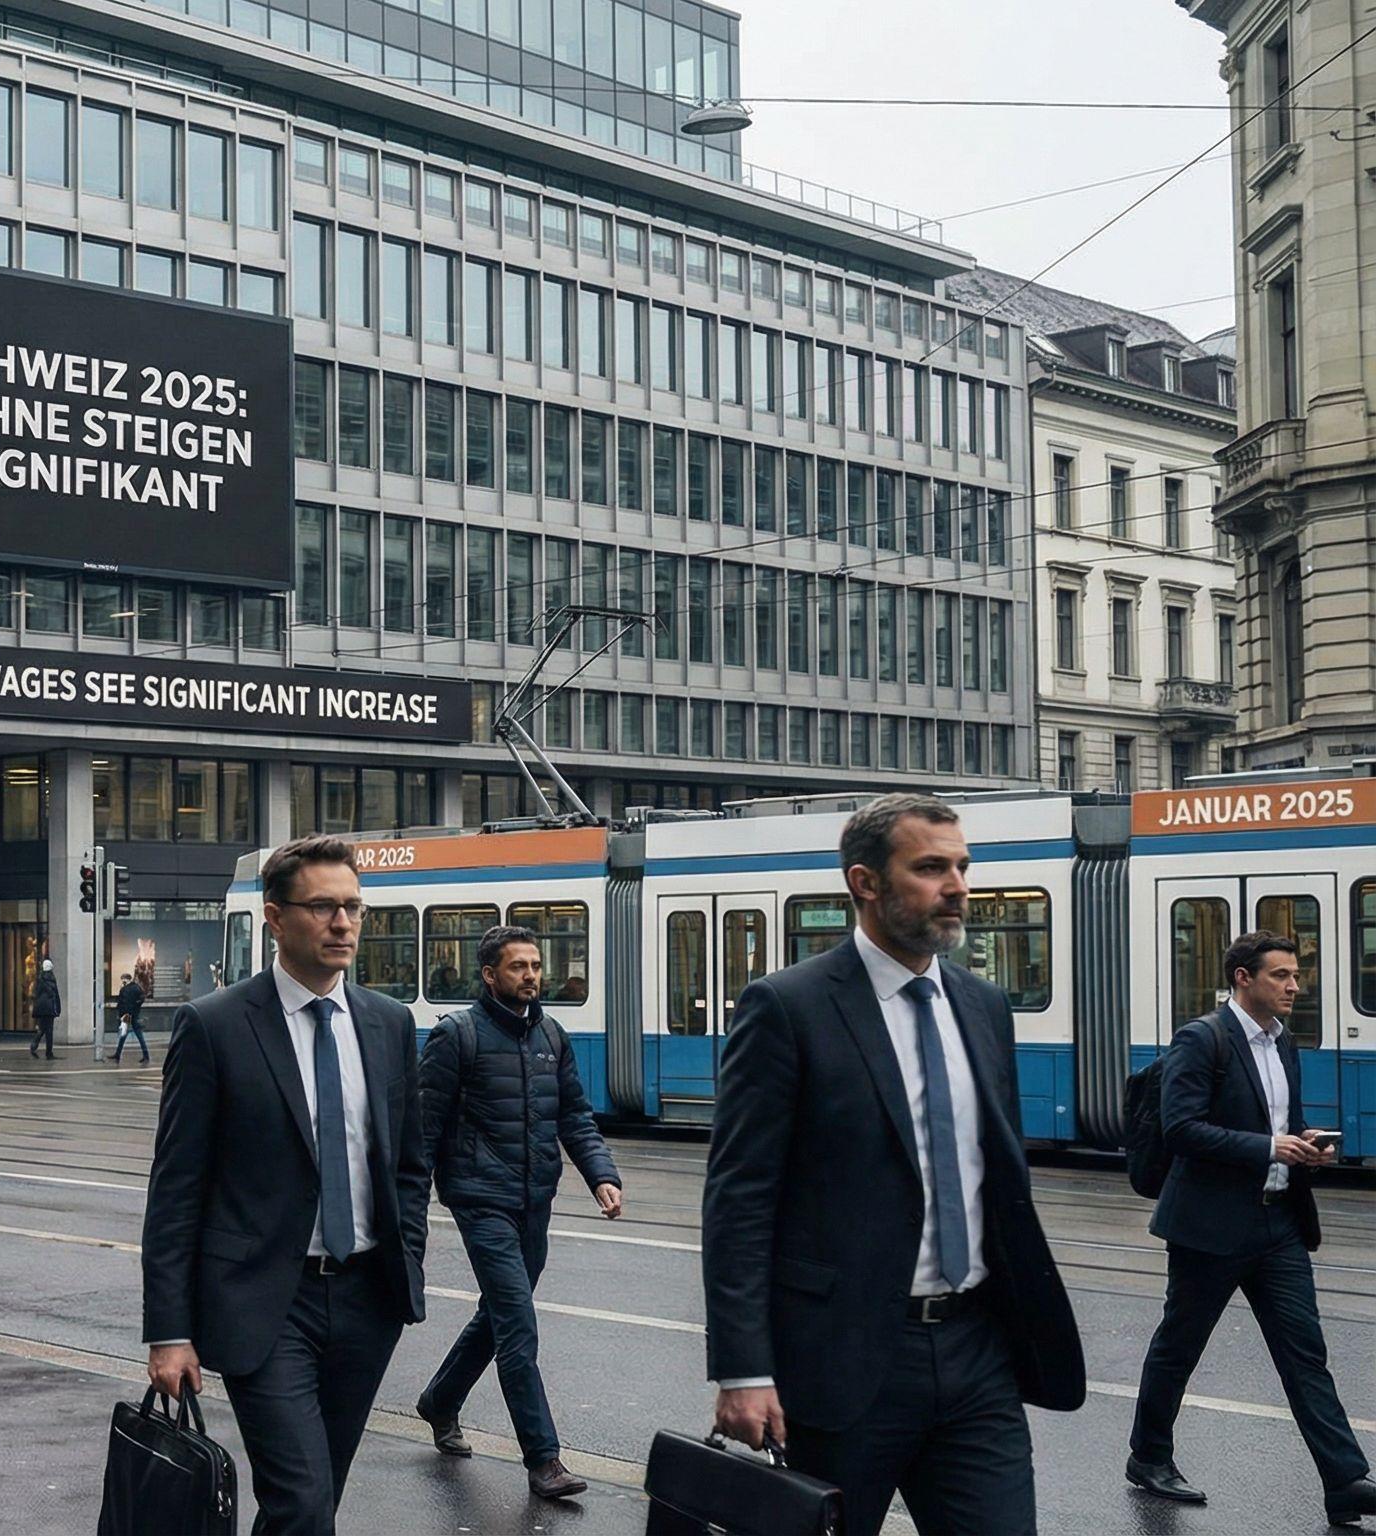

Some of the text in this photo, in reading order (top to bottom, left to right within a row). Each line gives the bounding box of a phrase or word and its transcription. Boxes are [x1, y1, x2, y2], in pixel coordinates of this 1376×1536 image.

[139, 366, 248, 418] 2025:
[82, 408, 252, 467] STEIGEN
[85, 672, 135, 704] SEE
[143, 676, 310, 715] SIGNIFICANT
[319, 688, 437, 723] INCREASE
[1159, 789, 1353, 825] JANUAR 2025
[355, 846, 414, 868] AR 2025
